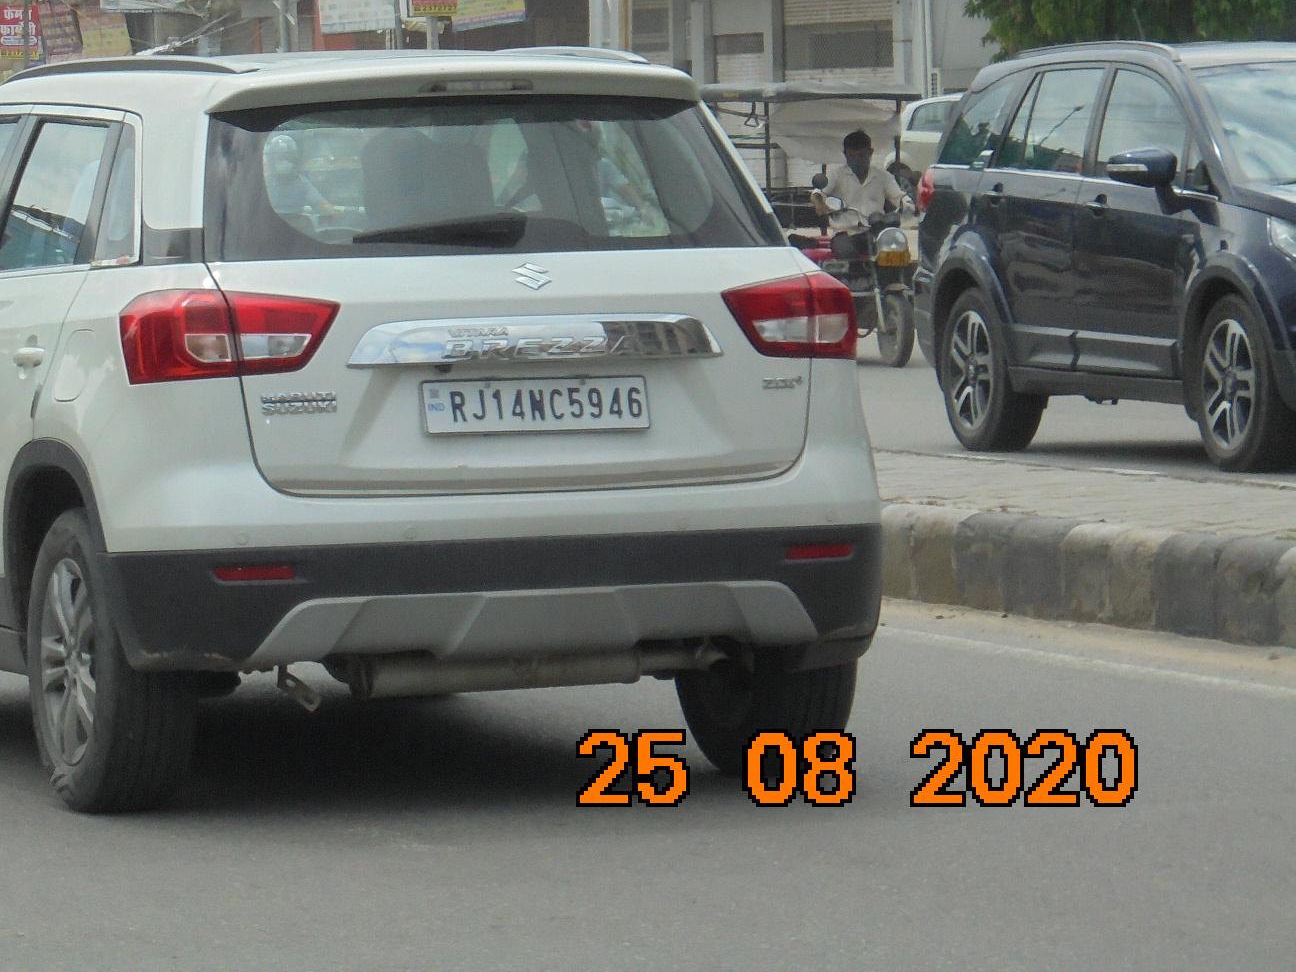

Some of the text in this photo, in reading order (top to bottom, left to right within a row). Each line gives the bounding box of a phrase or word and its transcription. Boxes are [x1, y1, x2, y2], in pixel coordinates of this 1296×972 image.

[448, 326, 510, 338] VITARA
[442, 334, 636, 361] BREZZA
[261, 400, 338, 416] SUZUKI
[427, 402, 446, 412] IND
[449, 386, 643, 423] RJ14NC5946
